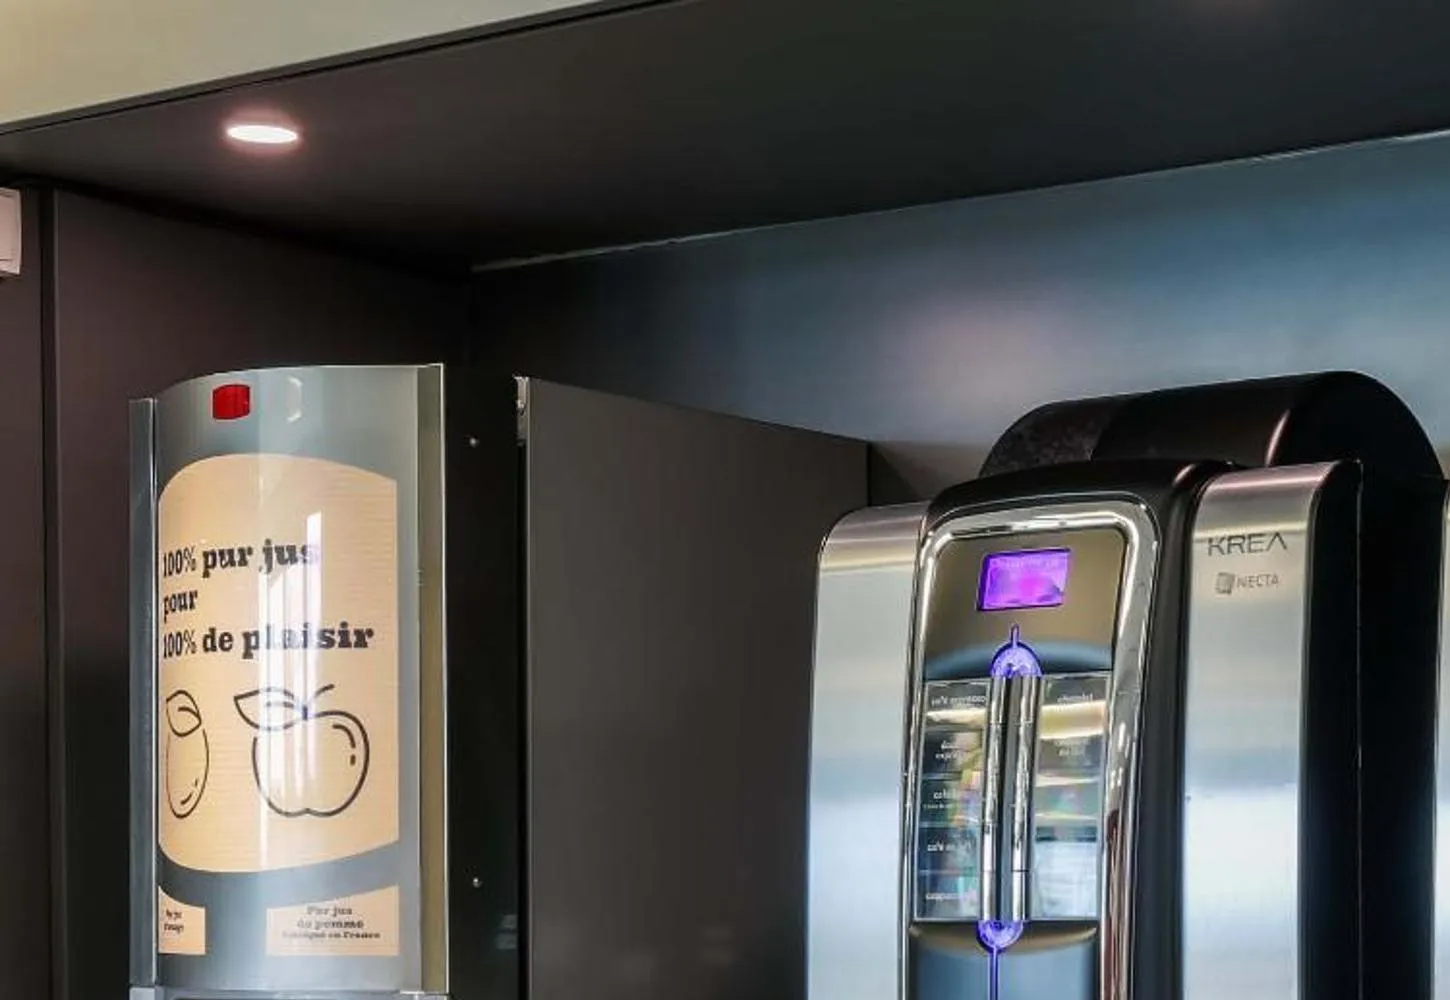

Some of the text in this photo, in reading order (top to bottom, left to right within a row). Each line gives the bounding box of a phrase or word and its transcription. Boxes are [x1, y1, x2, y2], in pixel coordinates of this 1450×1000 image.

[162, 538, 320, 578] 100% pur jus
[1237, 574, 1279, 588] NECTA
[162, 588, 198, 622] pour
[162, 621, 375, 660] 100% de plaisir
